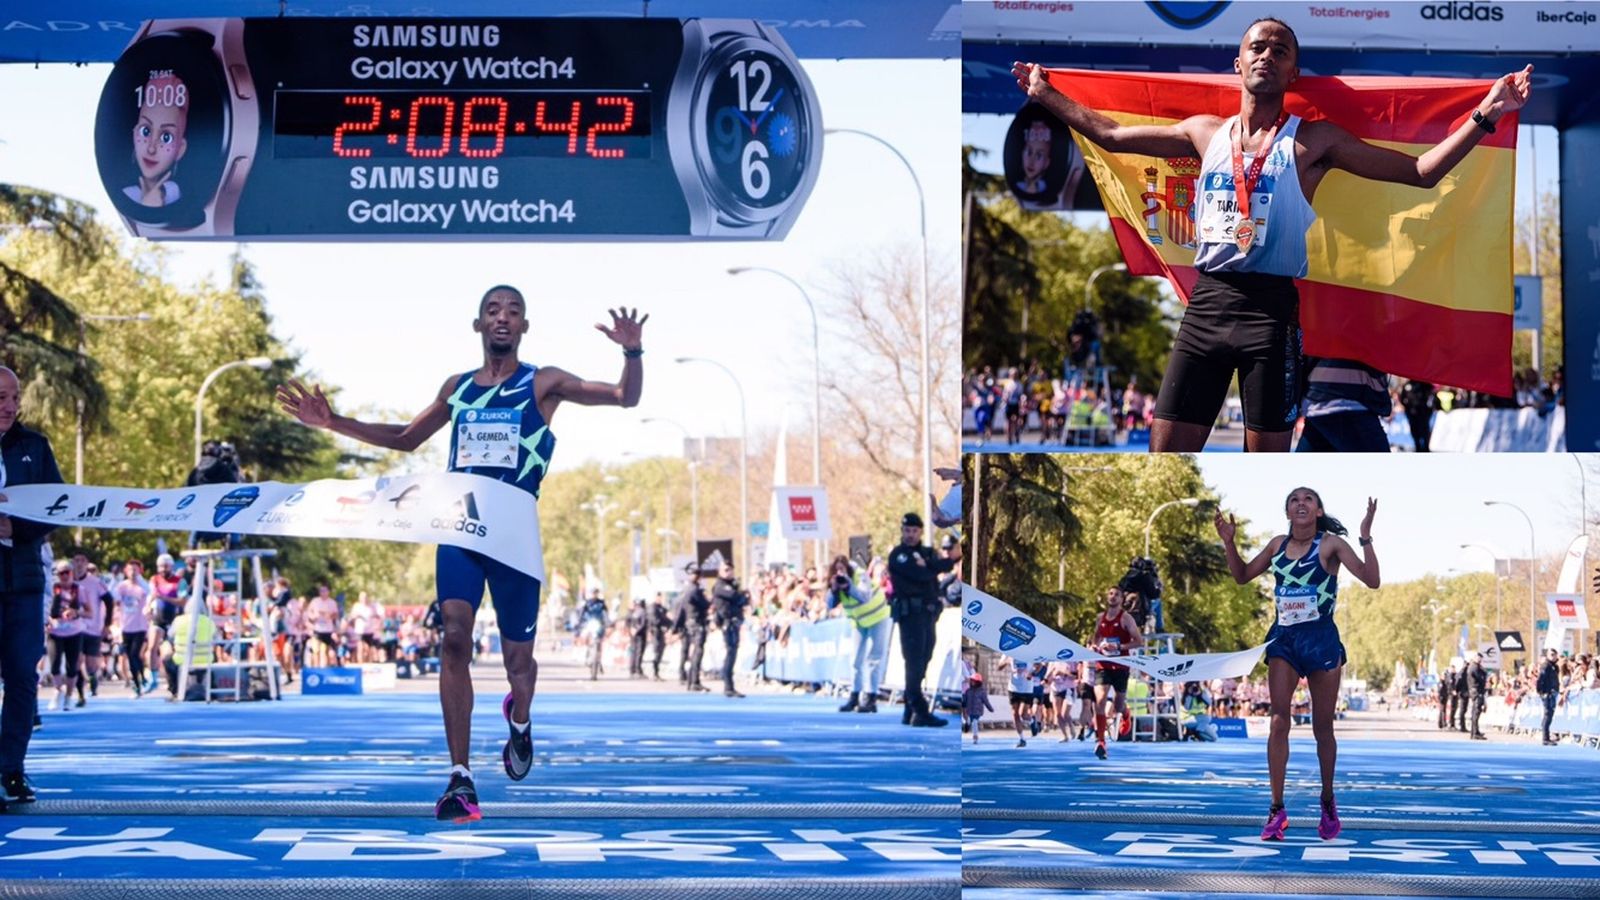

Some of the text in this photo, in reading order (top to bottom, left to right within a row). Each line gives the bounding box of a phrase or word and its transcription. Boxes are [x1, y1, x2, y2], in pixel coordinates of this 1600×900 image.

[993, 1, 1074, 13] TotalEnergies
[1309, 6, 1390, 20] TotalEnergies
[1420, 1, 1504, 21] adidas
[1537, 11, 1597, 25] iberCaja
[353, 25, 500, 48] SAMSUNG
[351, 56, 576, 86] Galaxy Watch4
[135, 84, 187, 108] 10:08
[729, 60, 774, 112] 12
[350, 167, 499, 190] SAMSUNG
[741, 140, 771, 200] 6
[347, 199, 576, 228] Galaxy Watch4
[479, 411, 512, 420] ZURICH
[466, 431, 510, 442] A. GEMEDA
